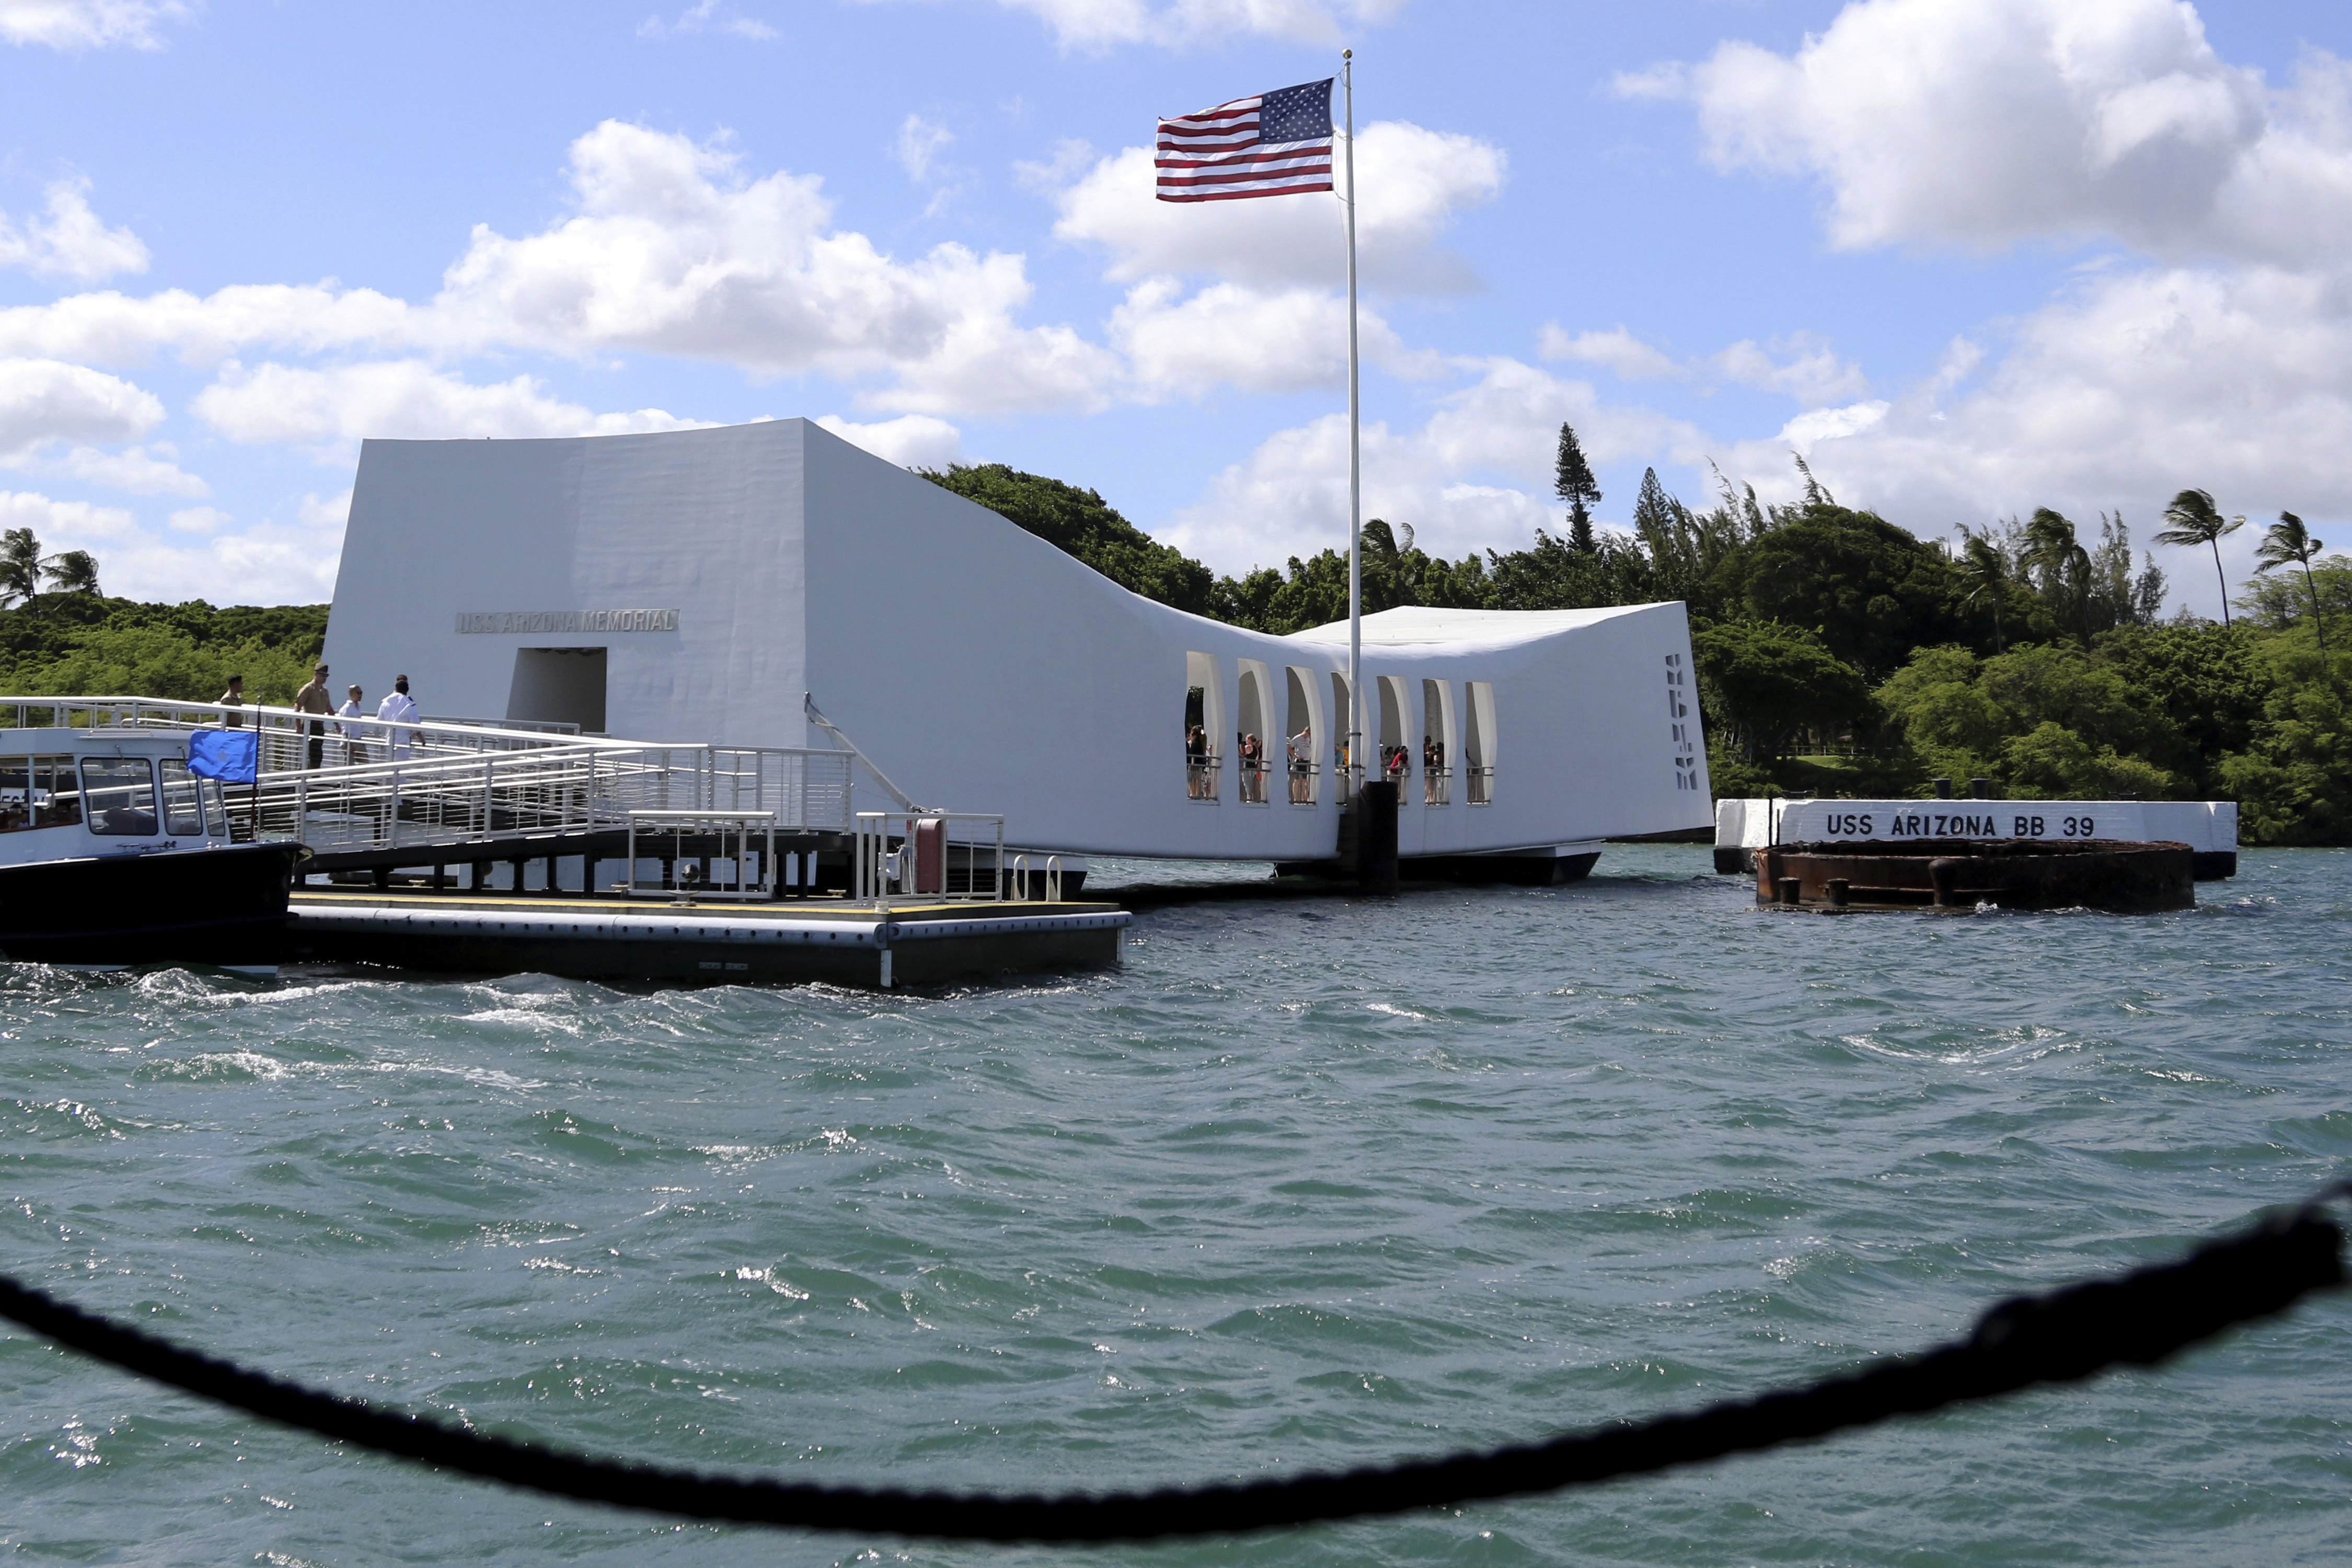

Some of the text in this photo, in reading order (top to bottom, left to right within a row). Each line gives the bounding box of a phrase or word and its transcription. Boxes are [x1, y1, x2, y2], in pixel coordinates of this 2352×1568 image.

[502, 612, 576, 633] ARIZONA
[582, 611, 673, 631] MEMORIAL
[1828, 815, 2094, 836] USS ARIZONA BB 39
